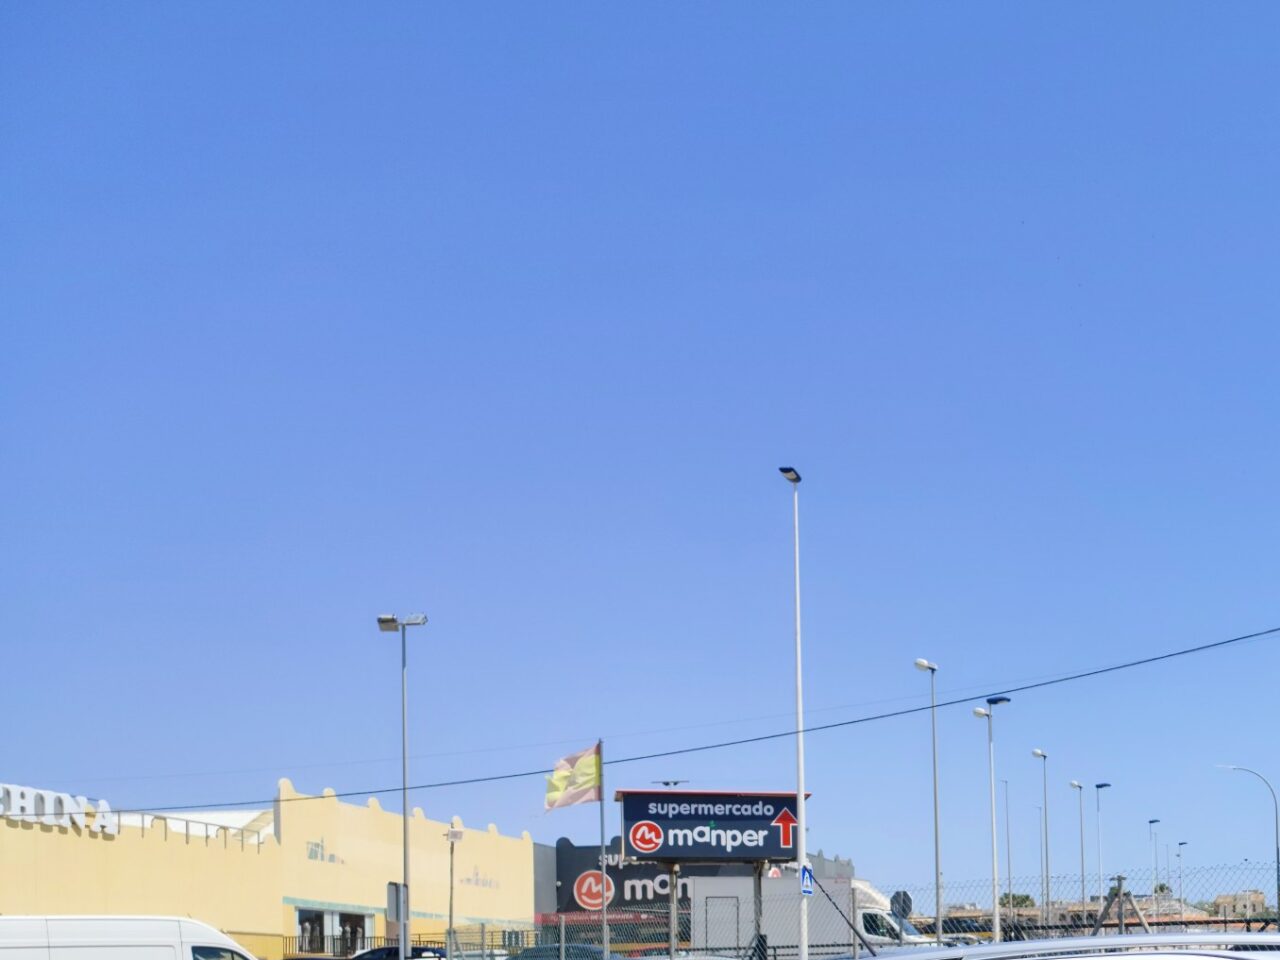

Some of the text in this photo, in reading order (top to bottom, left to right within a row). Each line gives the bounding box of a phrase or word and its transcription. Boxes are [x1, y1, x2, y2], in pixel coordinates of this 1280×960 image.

[0, 783, 117, 835] HINA
[648, 800, 775, 818] supermercado
[667, 824, 769, 853] manper
